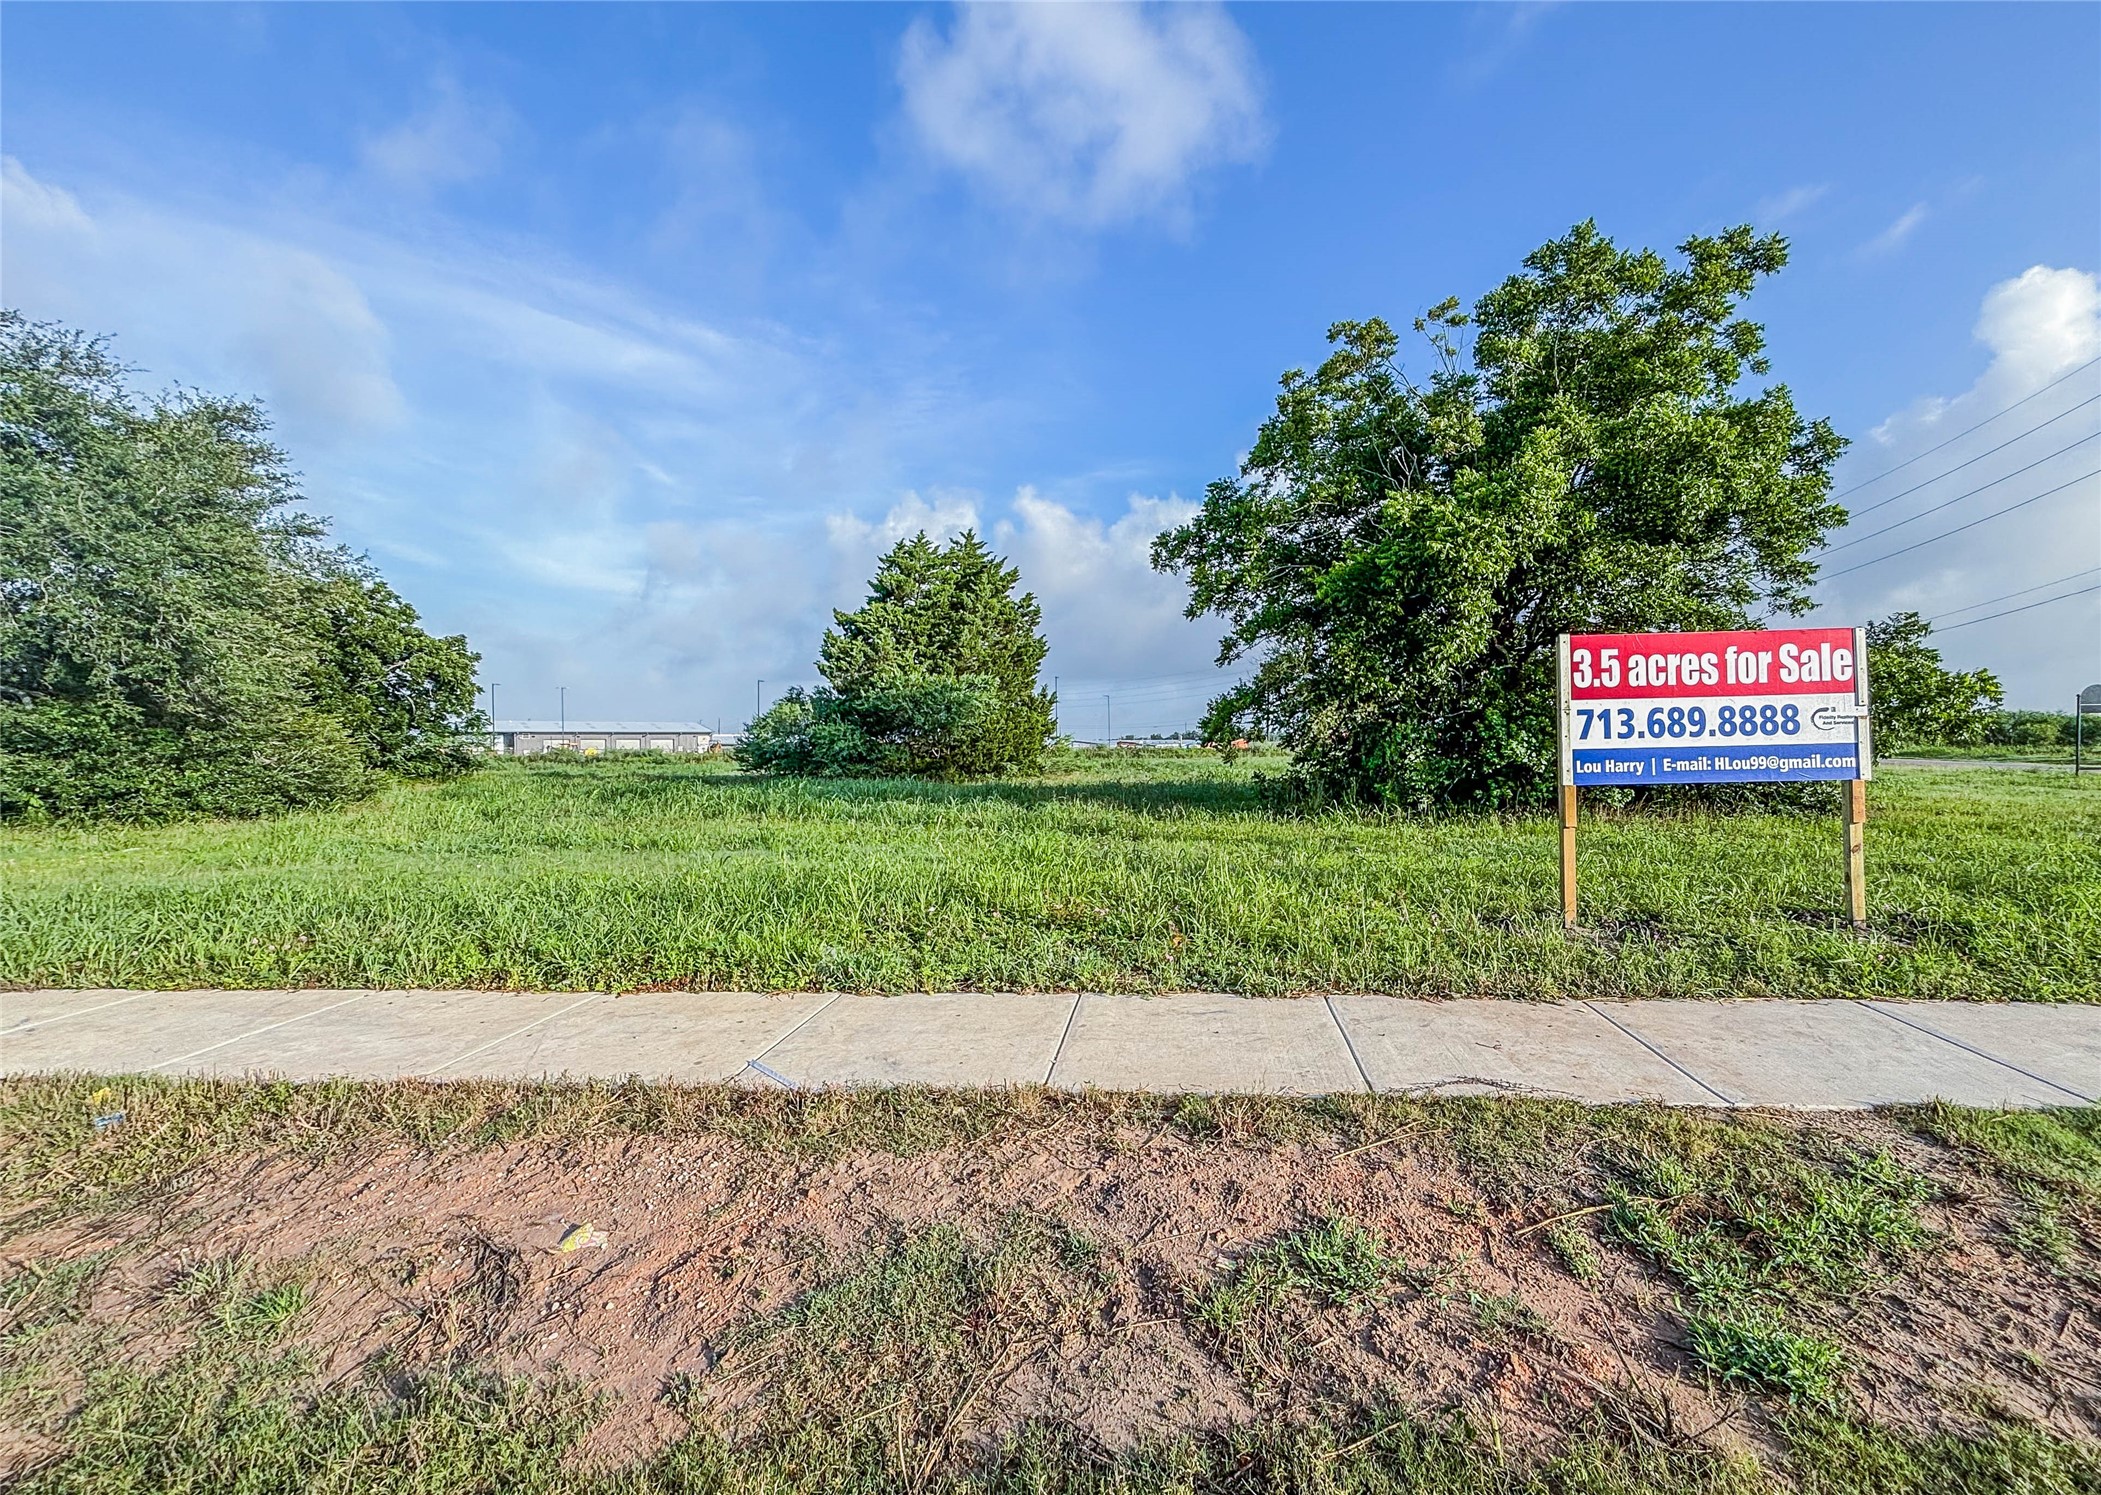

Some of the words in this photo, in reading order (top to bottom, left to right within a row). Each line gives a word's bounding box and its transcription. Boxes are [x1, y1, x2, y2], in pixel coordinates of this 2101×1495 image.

[1573, 648, 1621, 689] 3.5
[1628, 652, 1719, 687] acres
[1725, 646, 1772, 685] for
[1779, 643, 1853, 682] Sale
[1576, 704, 1800, 740] 713.689.8888
[1576, 760, 1600, 774] Lou
[1606, 759, 1643, 776] Harry
[1664, 756, 1711, 771] E-mail:
[1715, 755, 1856, 772] HLou99@gmail.com
